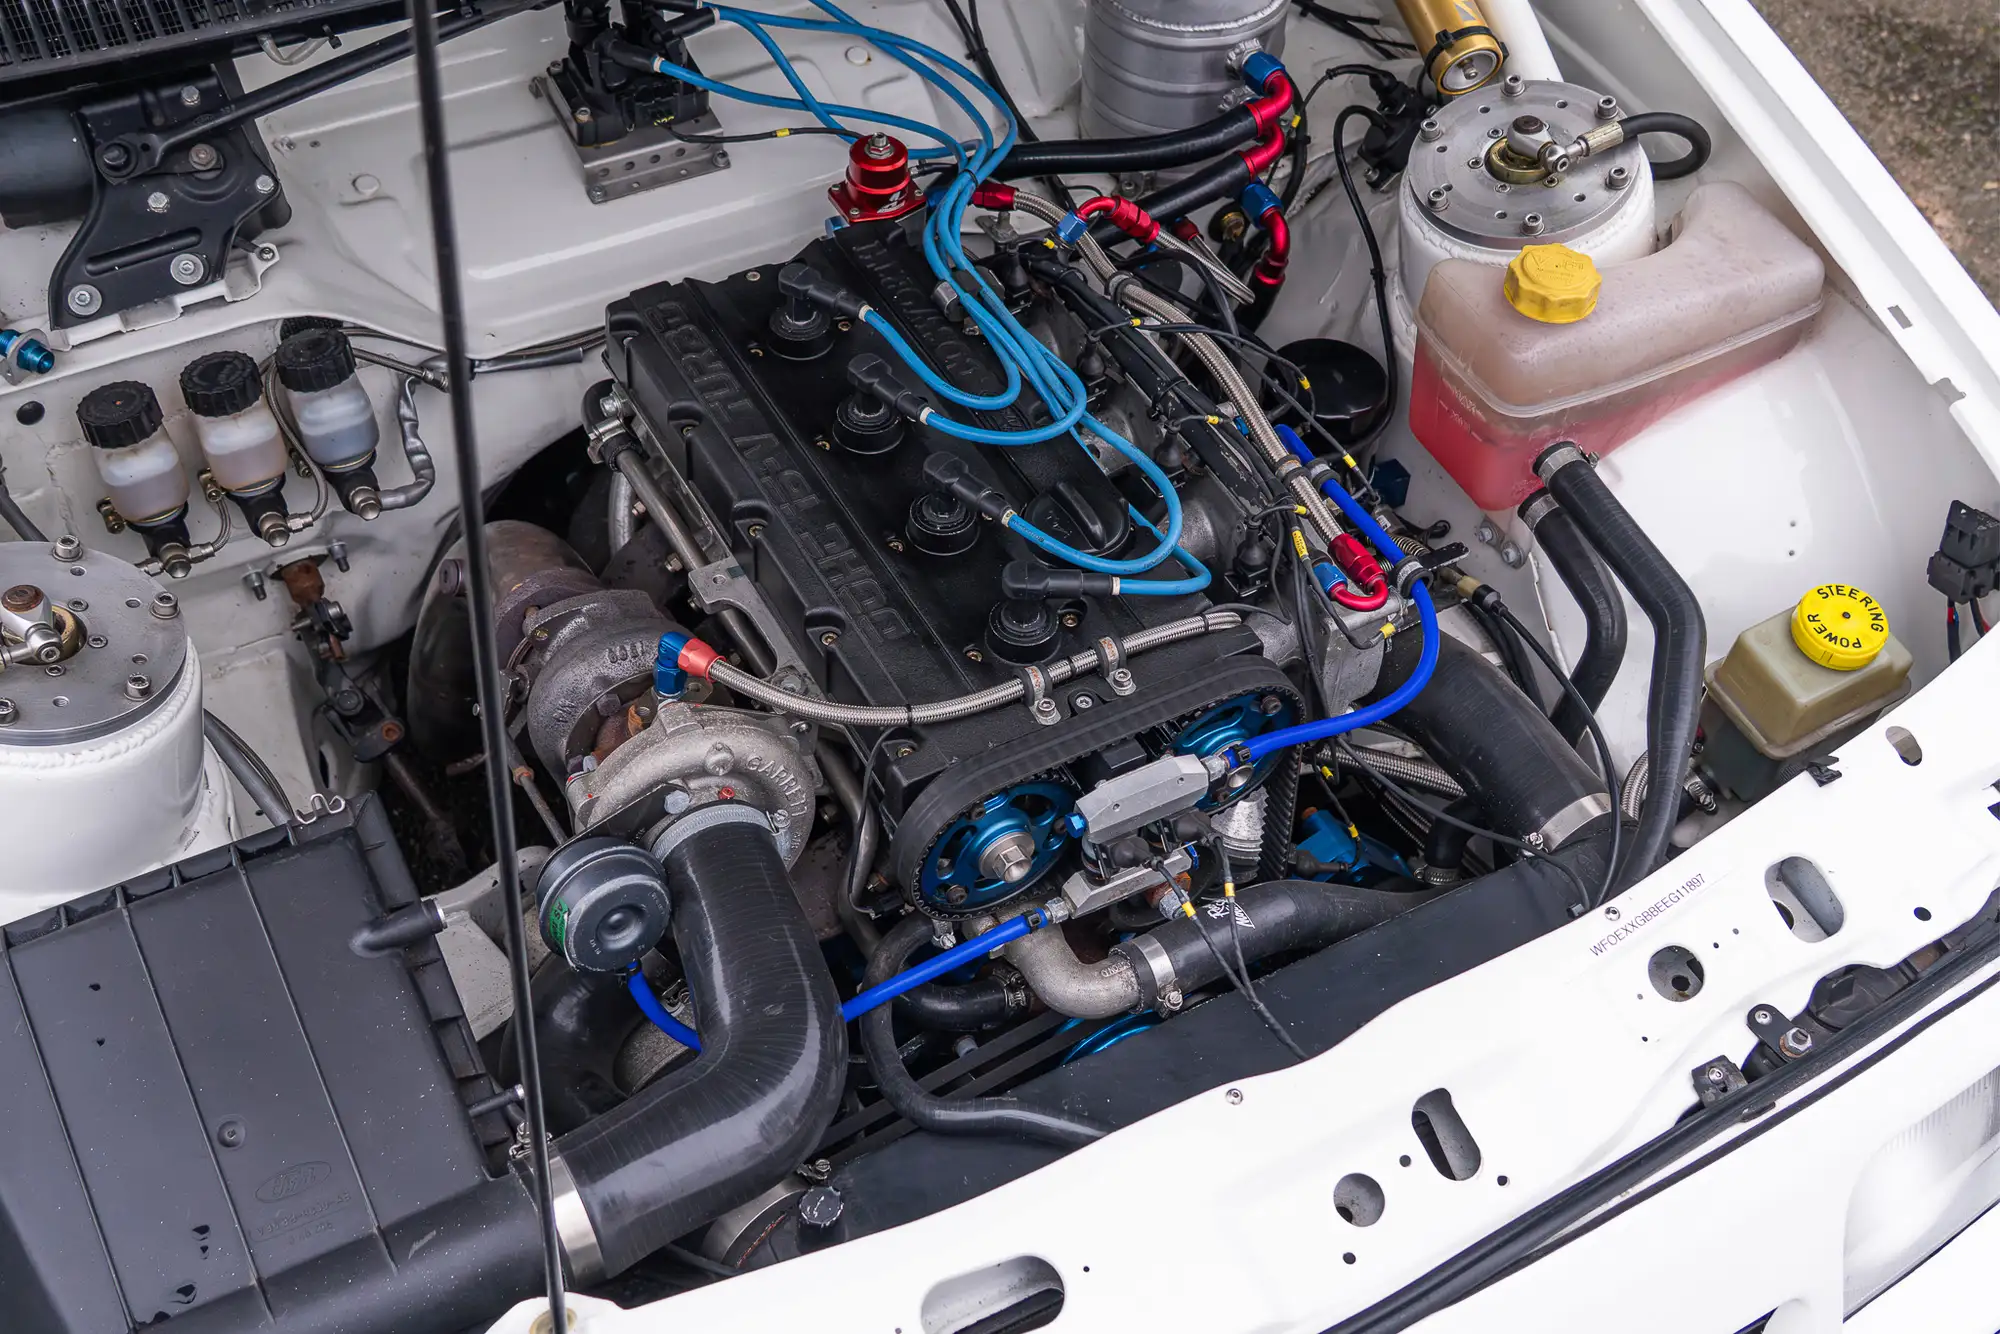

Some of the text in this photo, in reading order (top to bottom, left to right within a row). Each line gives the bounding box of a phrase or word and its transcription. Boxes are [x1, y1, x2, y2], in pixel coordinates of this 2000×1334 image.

[645, 301, 753, 425] TURBO
[1807, 584, 1885, 649] POWER STEERING
[746, 755, 808, 817] GARRETT
